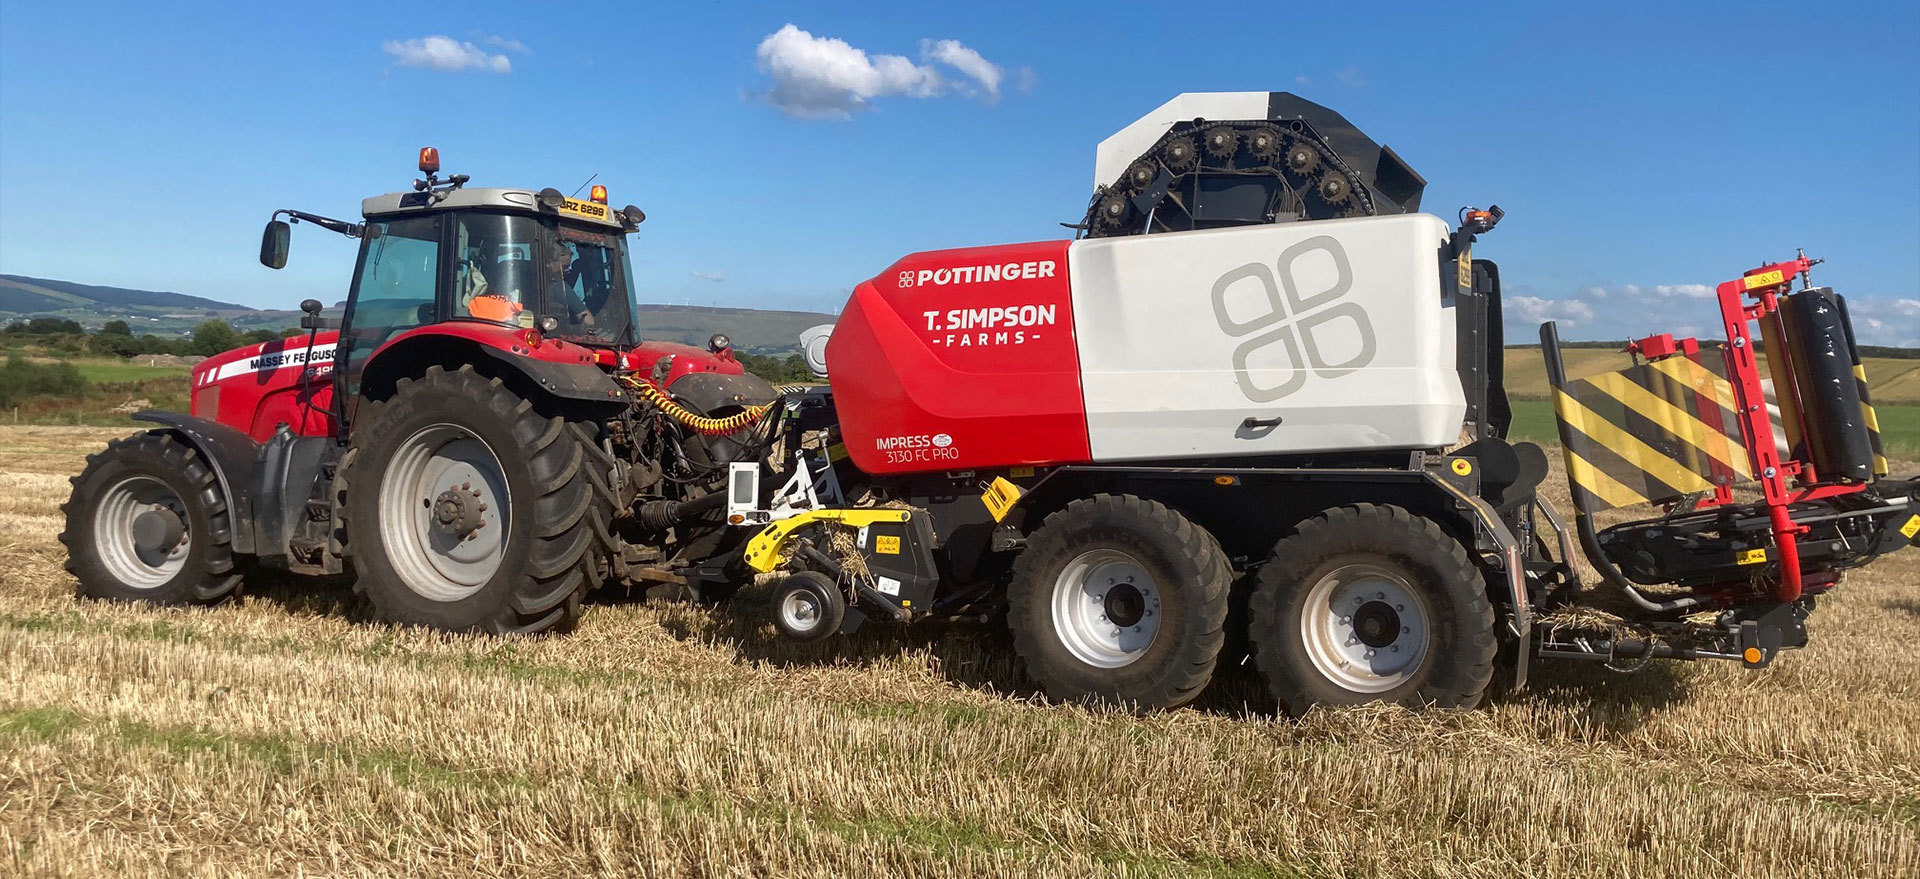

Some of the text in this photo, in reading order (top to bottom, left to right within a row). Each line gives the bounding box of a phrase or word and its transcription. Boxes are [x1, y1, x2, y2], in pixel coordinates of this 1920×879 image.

[580, 203, 604, 216] 6299
[923, 304, 1056, 331] T. SIMPSON
[250, 354, 291, 370] MASSEY
[876, 435, 931, 450] IMPRESS
[886, 447, 959, 463] 3130 FC PRO
